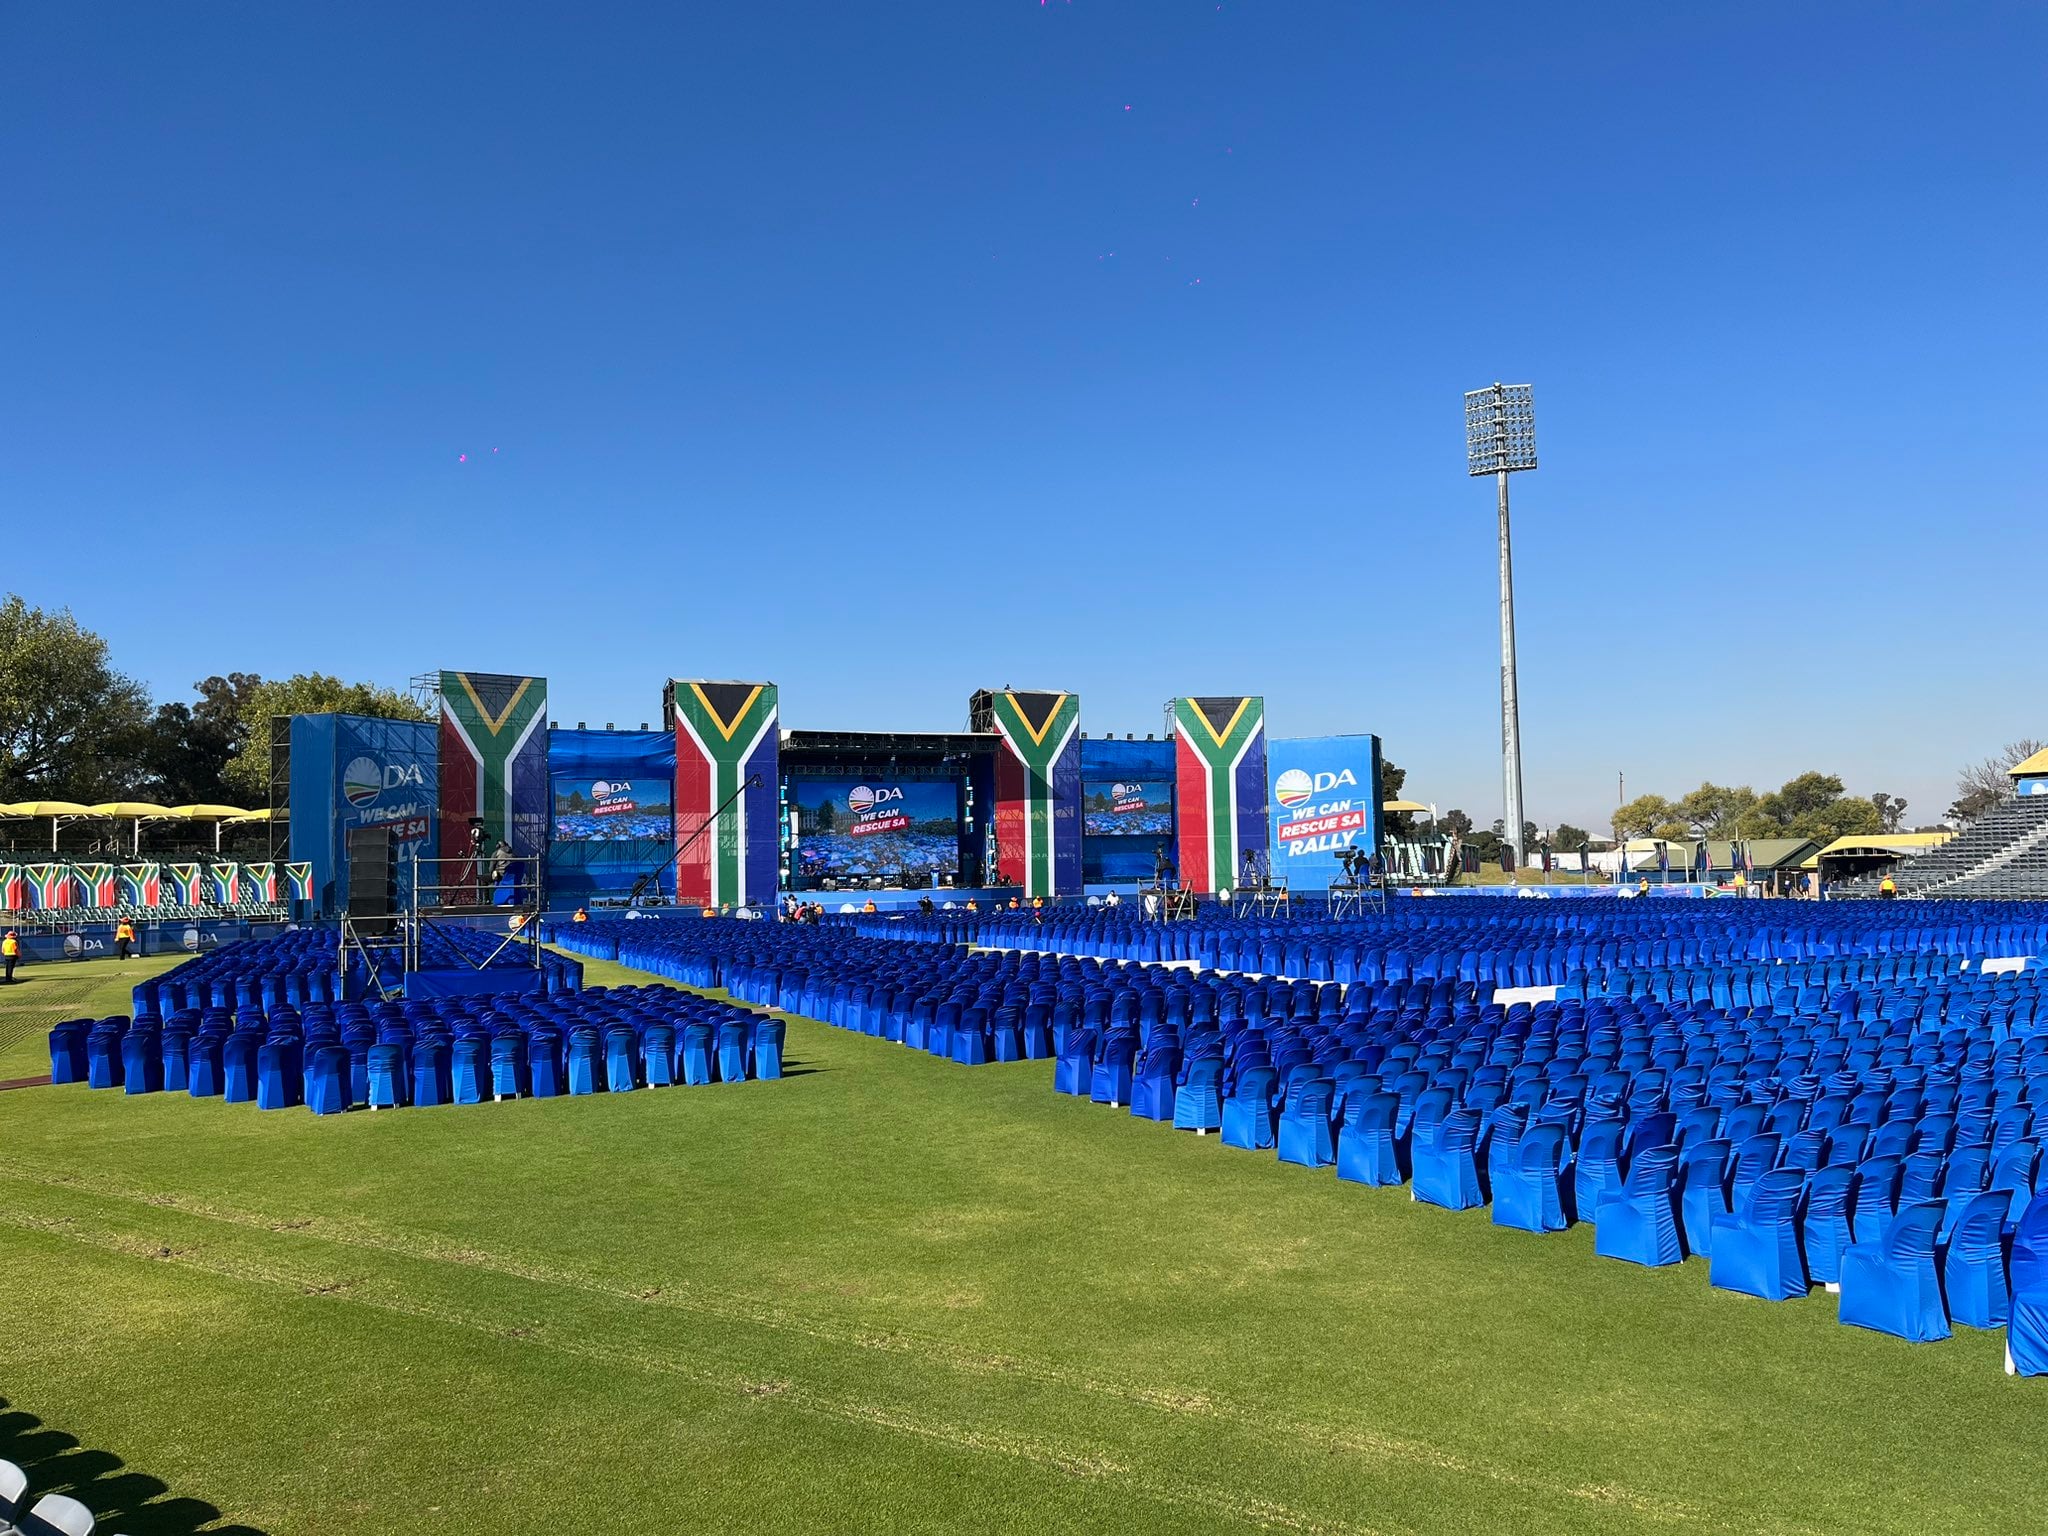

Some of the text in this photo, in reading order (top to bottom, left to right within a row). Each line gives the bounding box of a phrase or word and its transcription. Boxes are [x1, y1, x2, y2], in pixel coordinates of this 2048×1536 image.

[383, 764, 424, 789] DA
[1314, 768, 1358, 793] DA
[610, 782, 631, 793] DA
[875, 787, 904, 803] DA
[1126, 784, 1142, 794] DA
[600, 796, 628, 806] WE CAN
[360, 802, 417, 824] WE CAN
[594, 805, 621, 814] RESCUE
[860, 808, 899, 822] WE CAN
[1292, 799, 1351, 820] WE CAN
[407, 820, 426, 835] SA
[853, 818, 906, 834] RESCUE SA
[1281, 813, 1361, 838] RESCUE SA
[1288, 829, 1358, 857] RALLY
[83, 939, 104, 951] DA
[200, 933, 218, 943] DA
